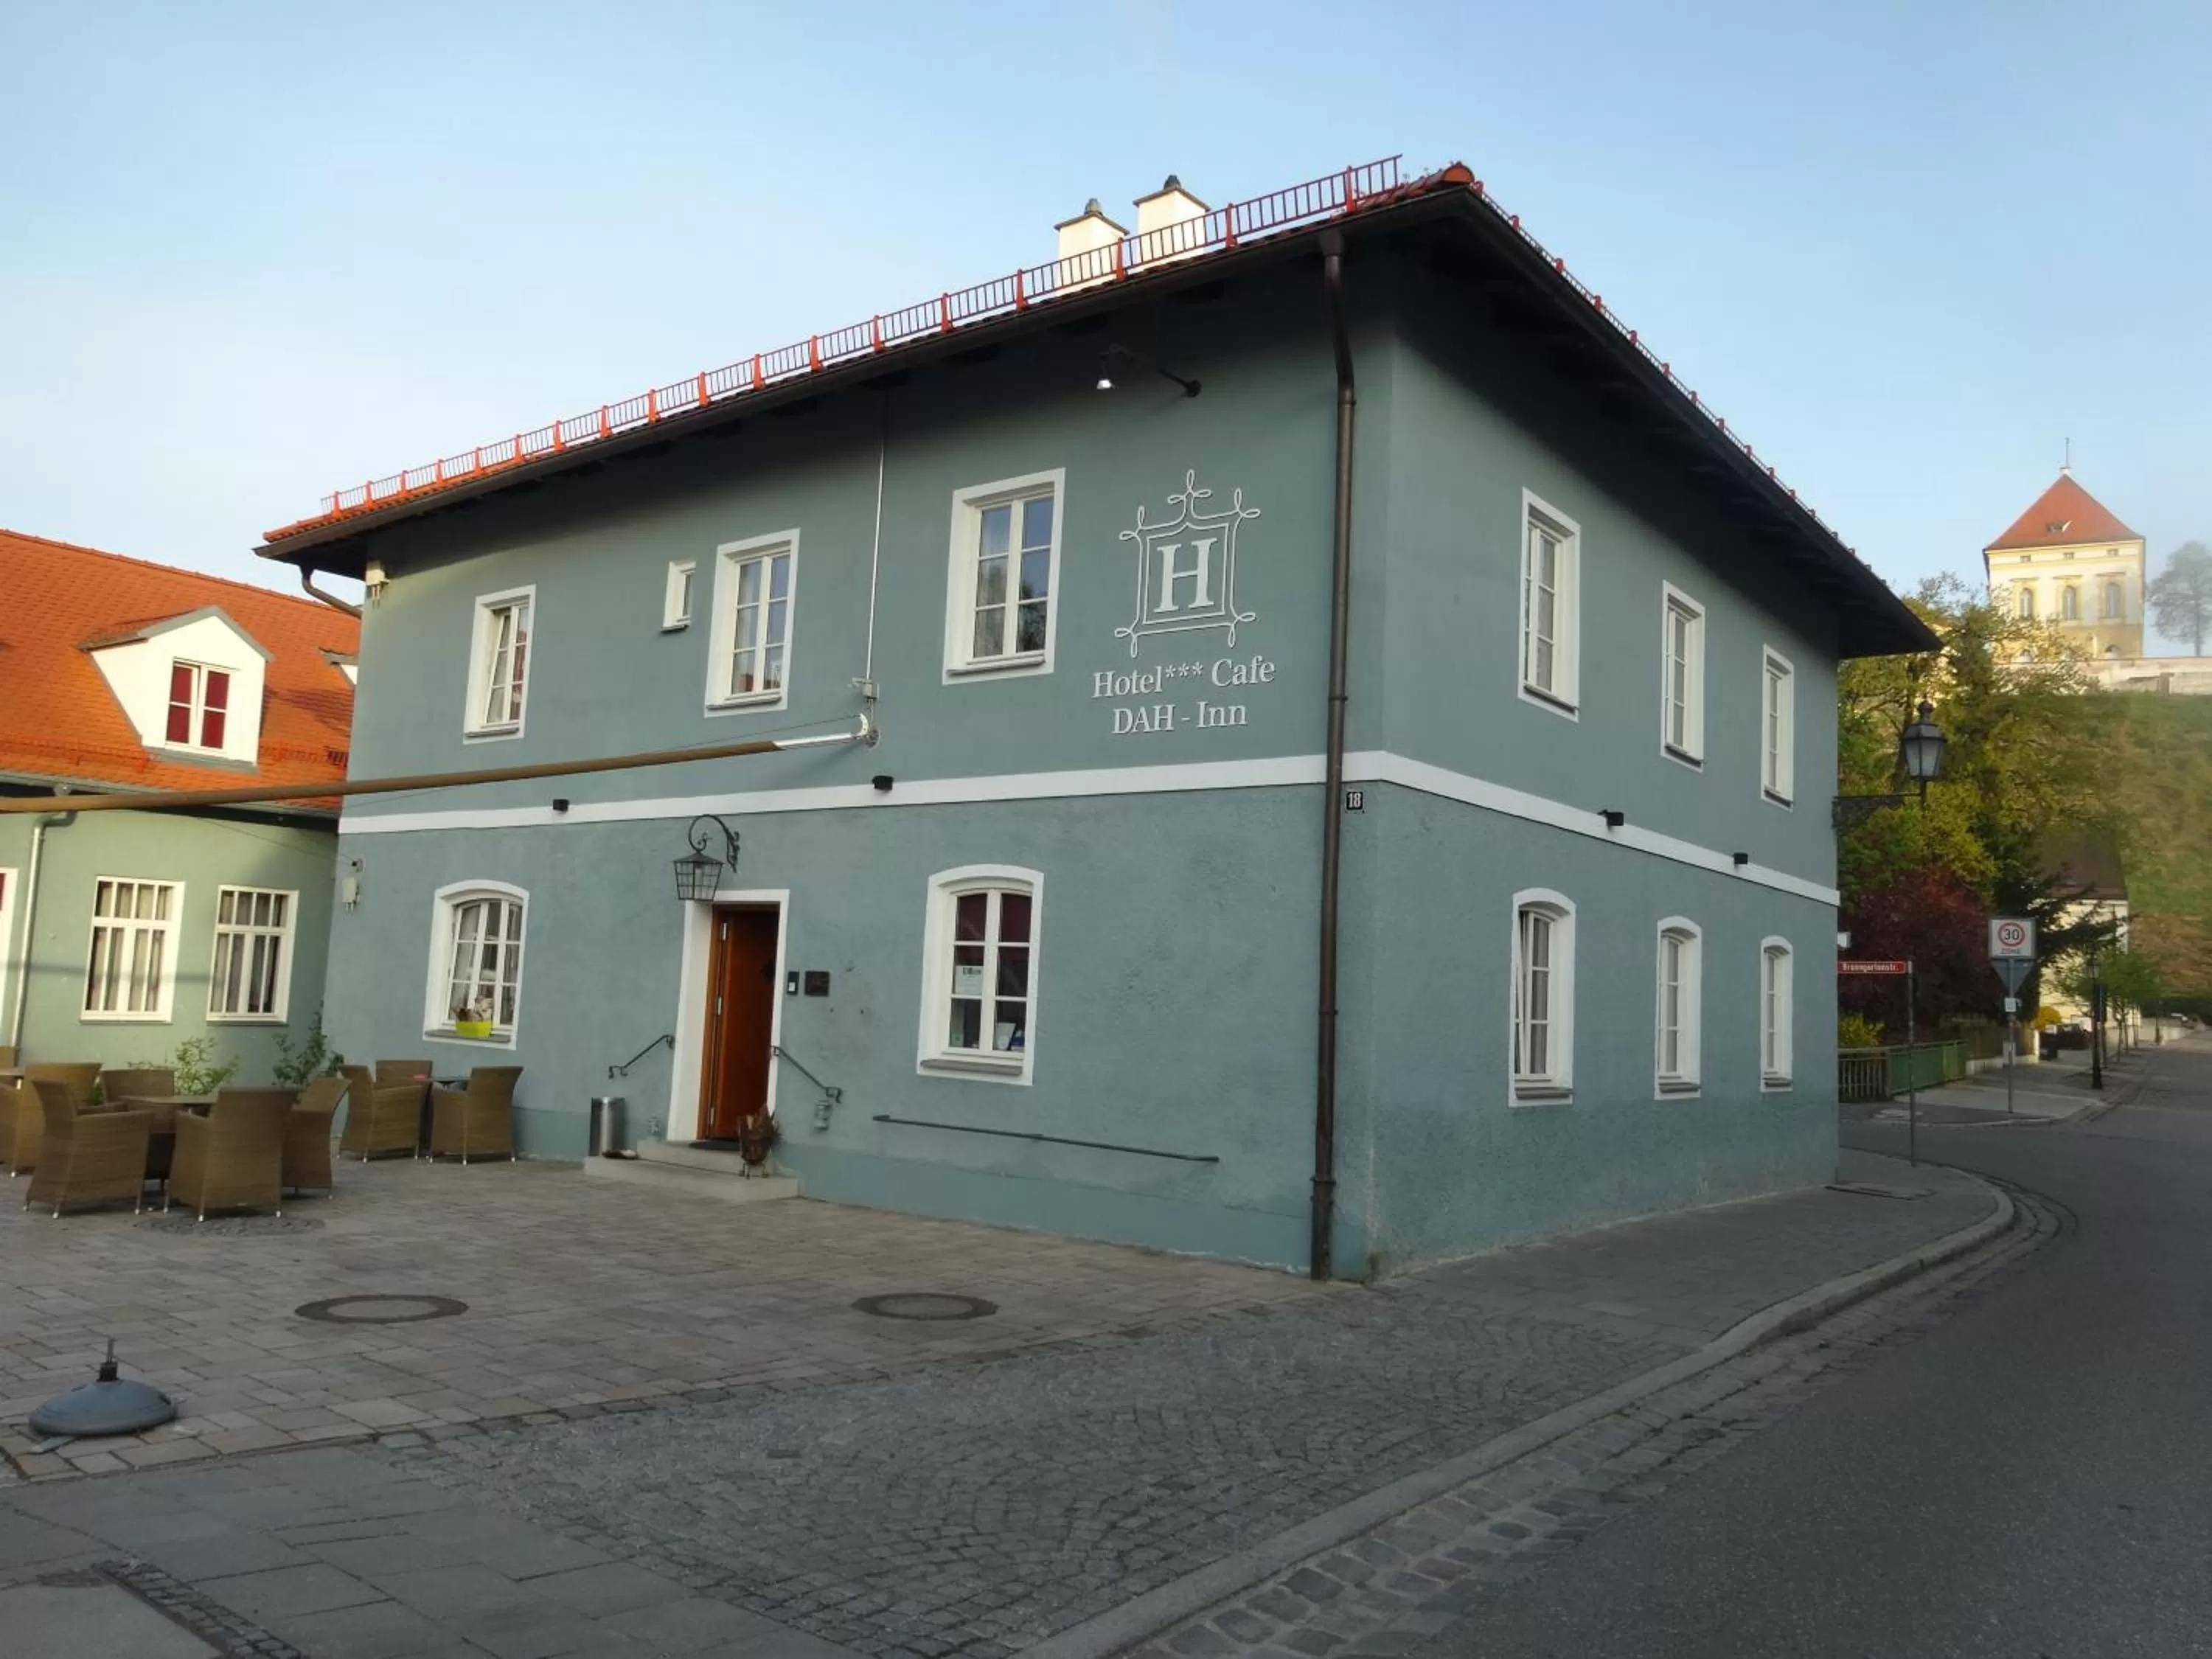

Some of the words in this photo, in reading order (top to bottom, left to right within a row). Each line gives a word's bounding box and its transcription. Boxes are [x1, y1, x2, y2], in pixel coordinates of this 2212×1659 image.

[1153, 537, 1218, 613] H
[1211, 655, 1276, 687] Cafe
[1111, 704, 1177, 734] DAH
[1196, 701, 1248, 728] Inn
[1348, 793, 1362, 808] 18
[2004, 928, 2020, 940] 30
